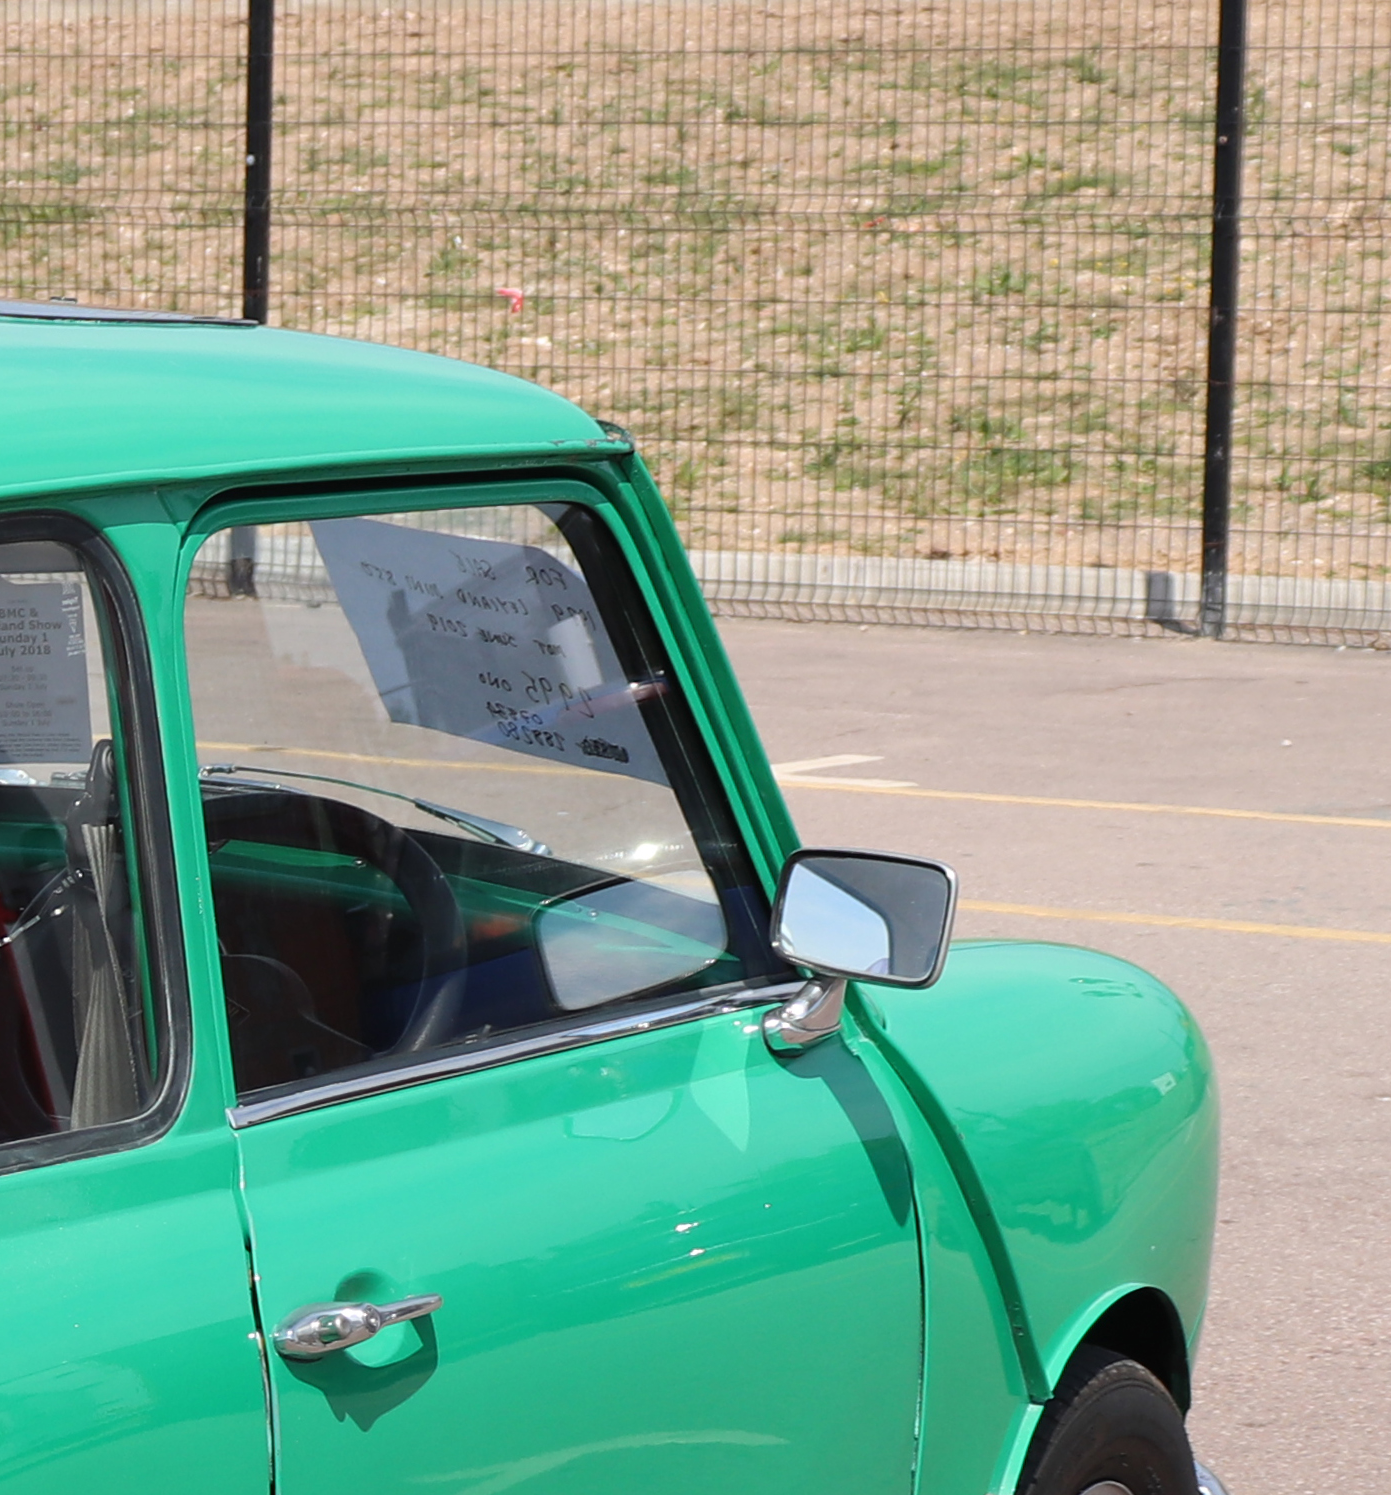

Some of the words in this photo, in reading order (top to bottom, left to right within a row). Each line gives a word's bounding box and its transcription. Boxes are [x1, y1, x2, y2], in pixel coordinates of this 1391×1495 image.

[30, 608, 38, 618] &
[29, 620, 62, 630] Show
[42, 632, 48, 642] 1
[21, 645, 51, 656] 2018
